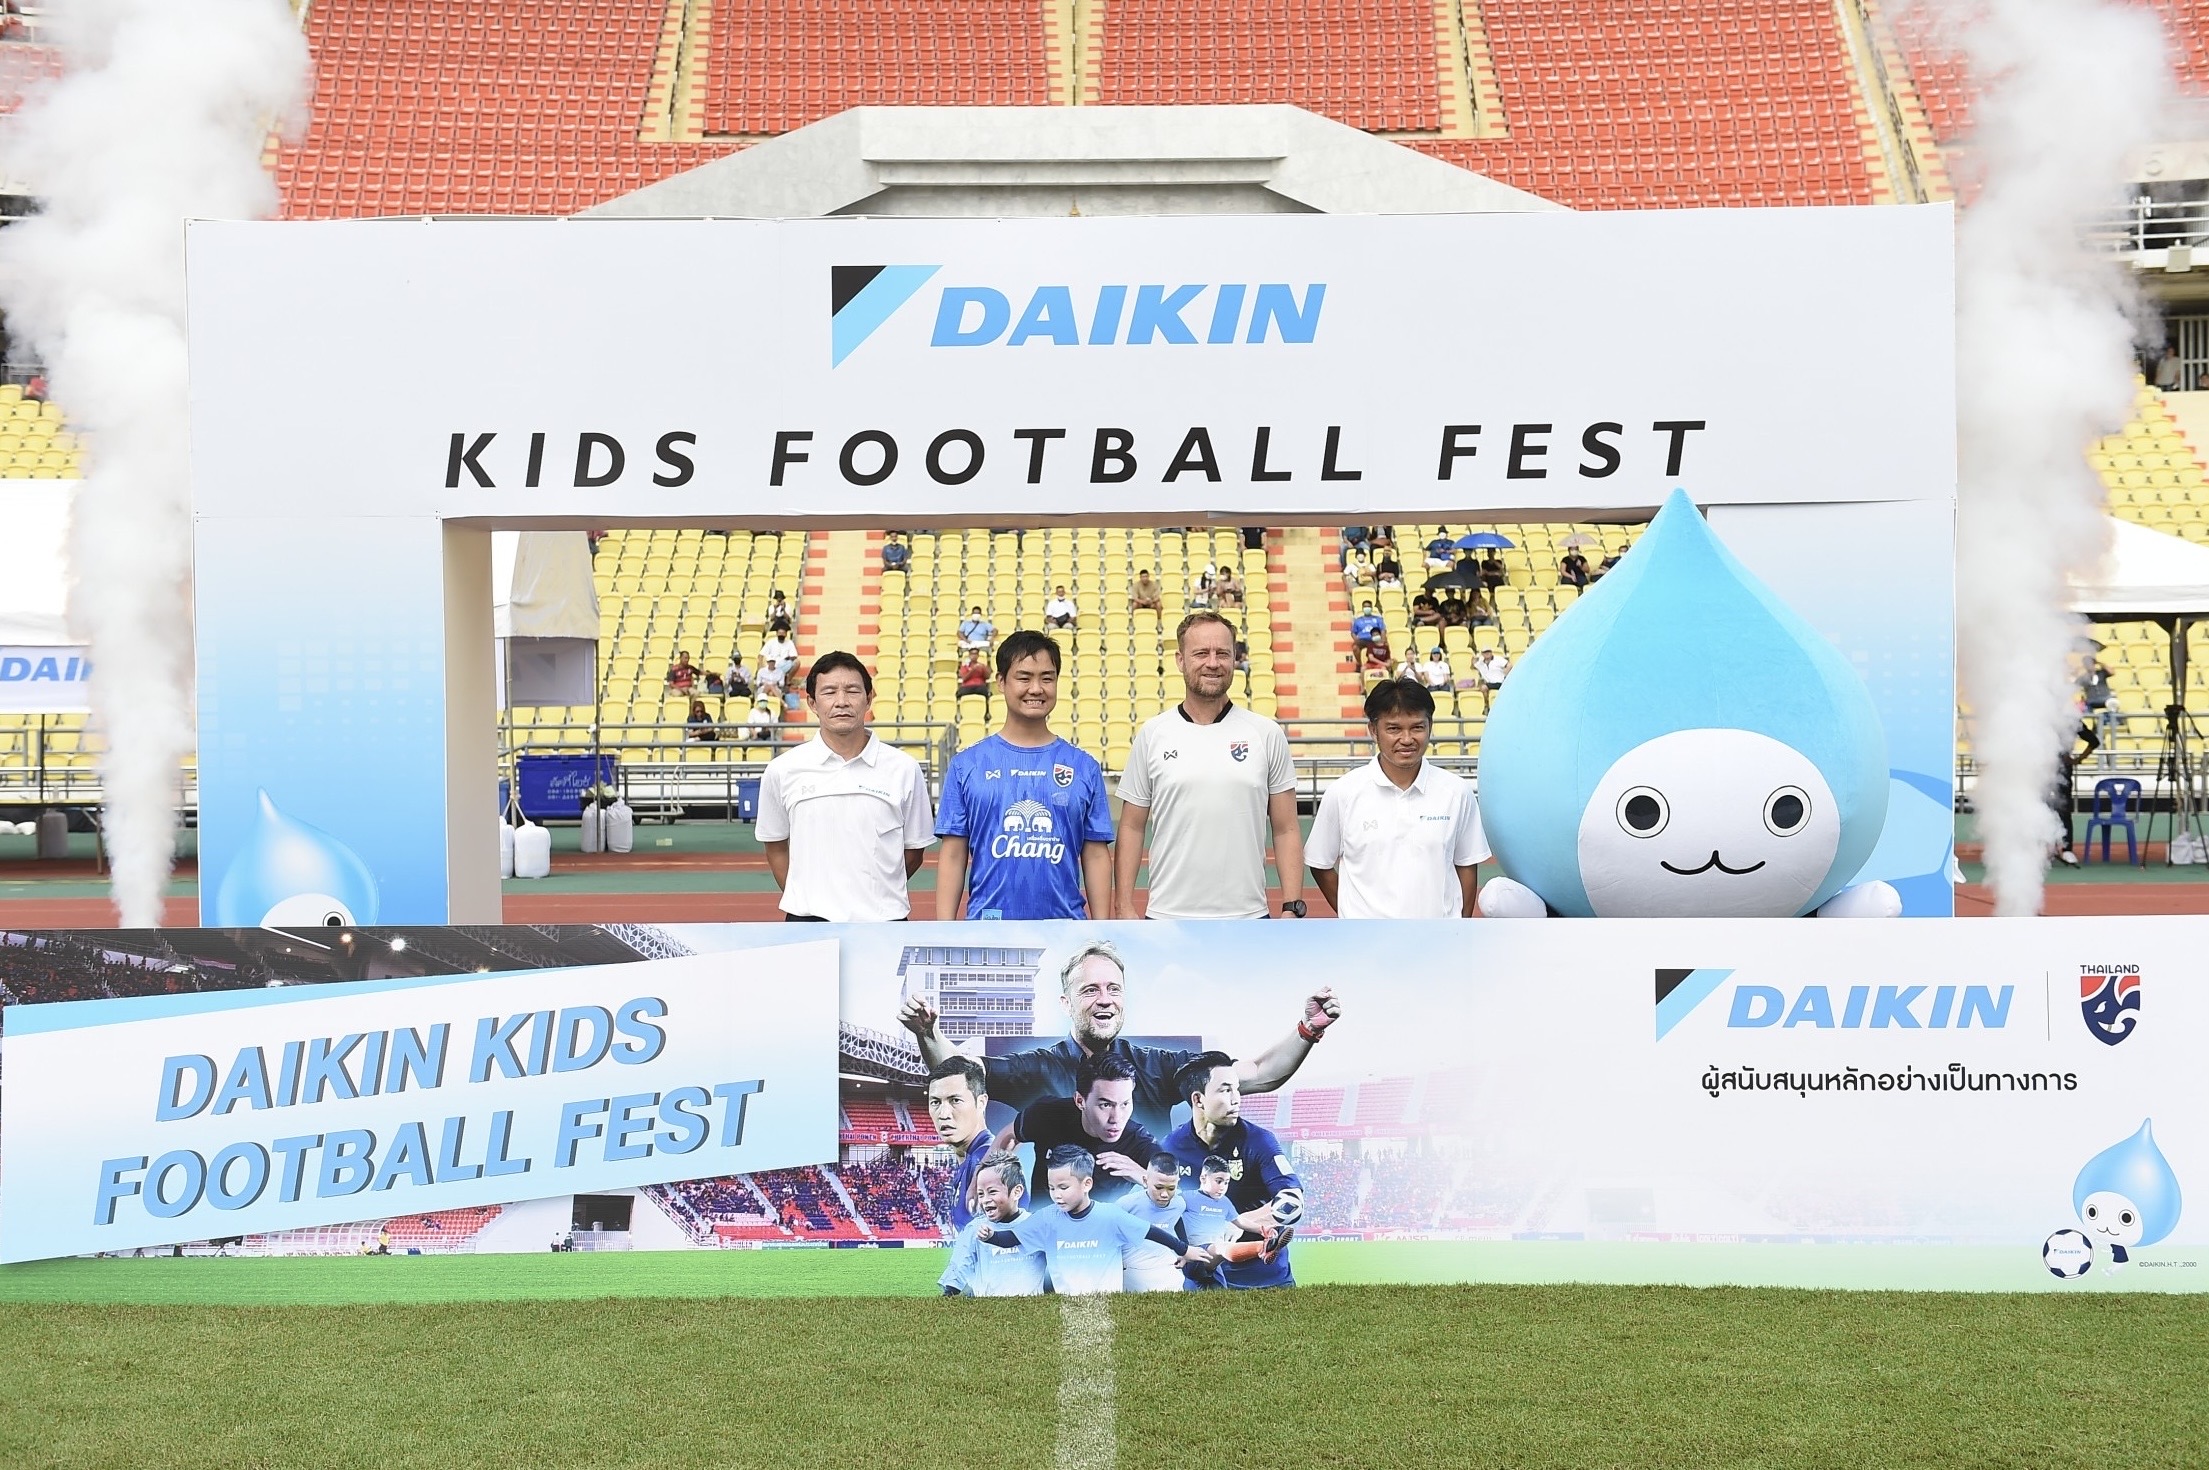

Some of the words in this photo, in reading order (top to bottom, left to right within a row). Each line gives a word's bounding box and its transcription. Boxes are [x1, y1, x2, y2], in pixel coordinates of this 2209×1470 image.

[931, 284, 1327, 347] DAIKIN
[446, 432, 697, 487] KIDS
[770, 426, 1363, 486] FOOTBALL
[1438, 421, 1706, 480] FEST
[991, 834, 1065, 865] Chang
[2080, 964, 2140, 974] THAILAND
[1728, 986, 2014, 1029] DAIKIN
[156, 1023, 450, 1122] DAIKIN
[468, 997, 668, 1083] KIDS
[1701, 1062, 2078, 1099] ผู้สนับสนุนหลักอย่างเป็นทางการ
[93, 1110, 532, 1226] FOOTBALL
[553, 1079, 765, 1168] FEST
[1064, 1240, 1099, 1249] DAIKIN
